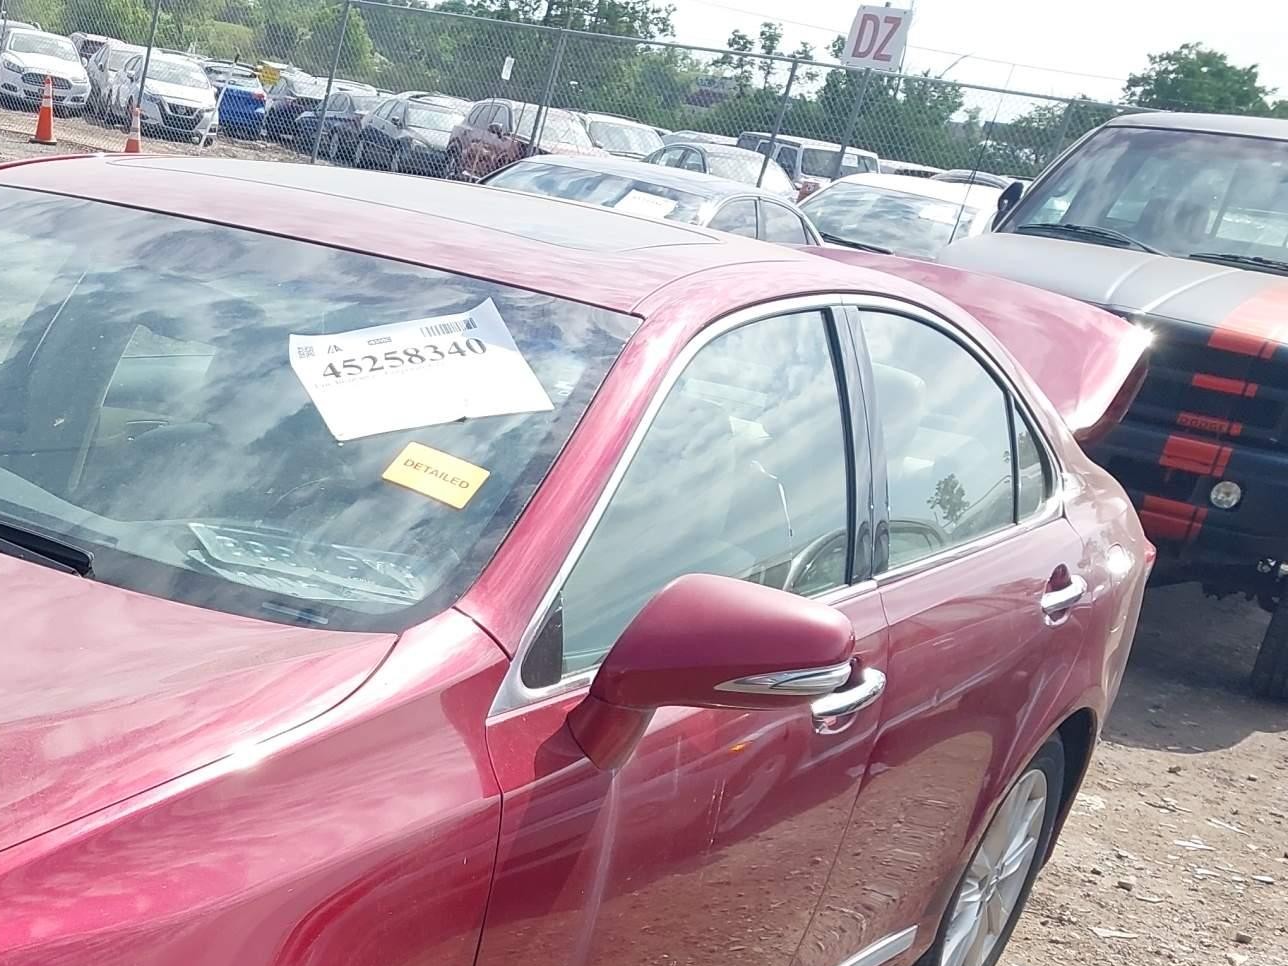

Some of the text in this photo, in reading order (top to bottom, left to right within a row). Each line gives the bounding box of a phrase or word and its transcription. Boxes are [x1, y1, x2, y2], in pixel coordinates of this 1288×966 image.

[851, 13, 902, 62] DZ
[322, 337, 488, 379] 45258340
[402, 458, 470, 489] DETAILED
